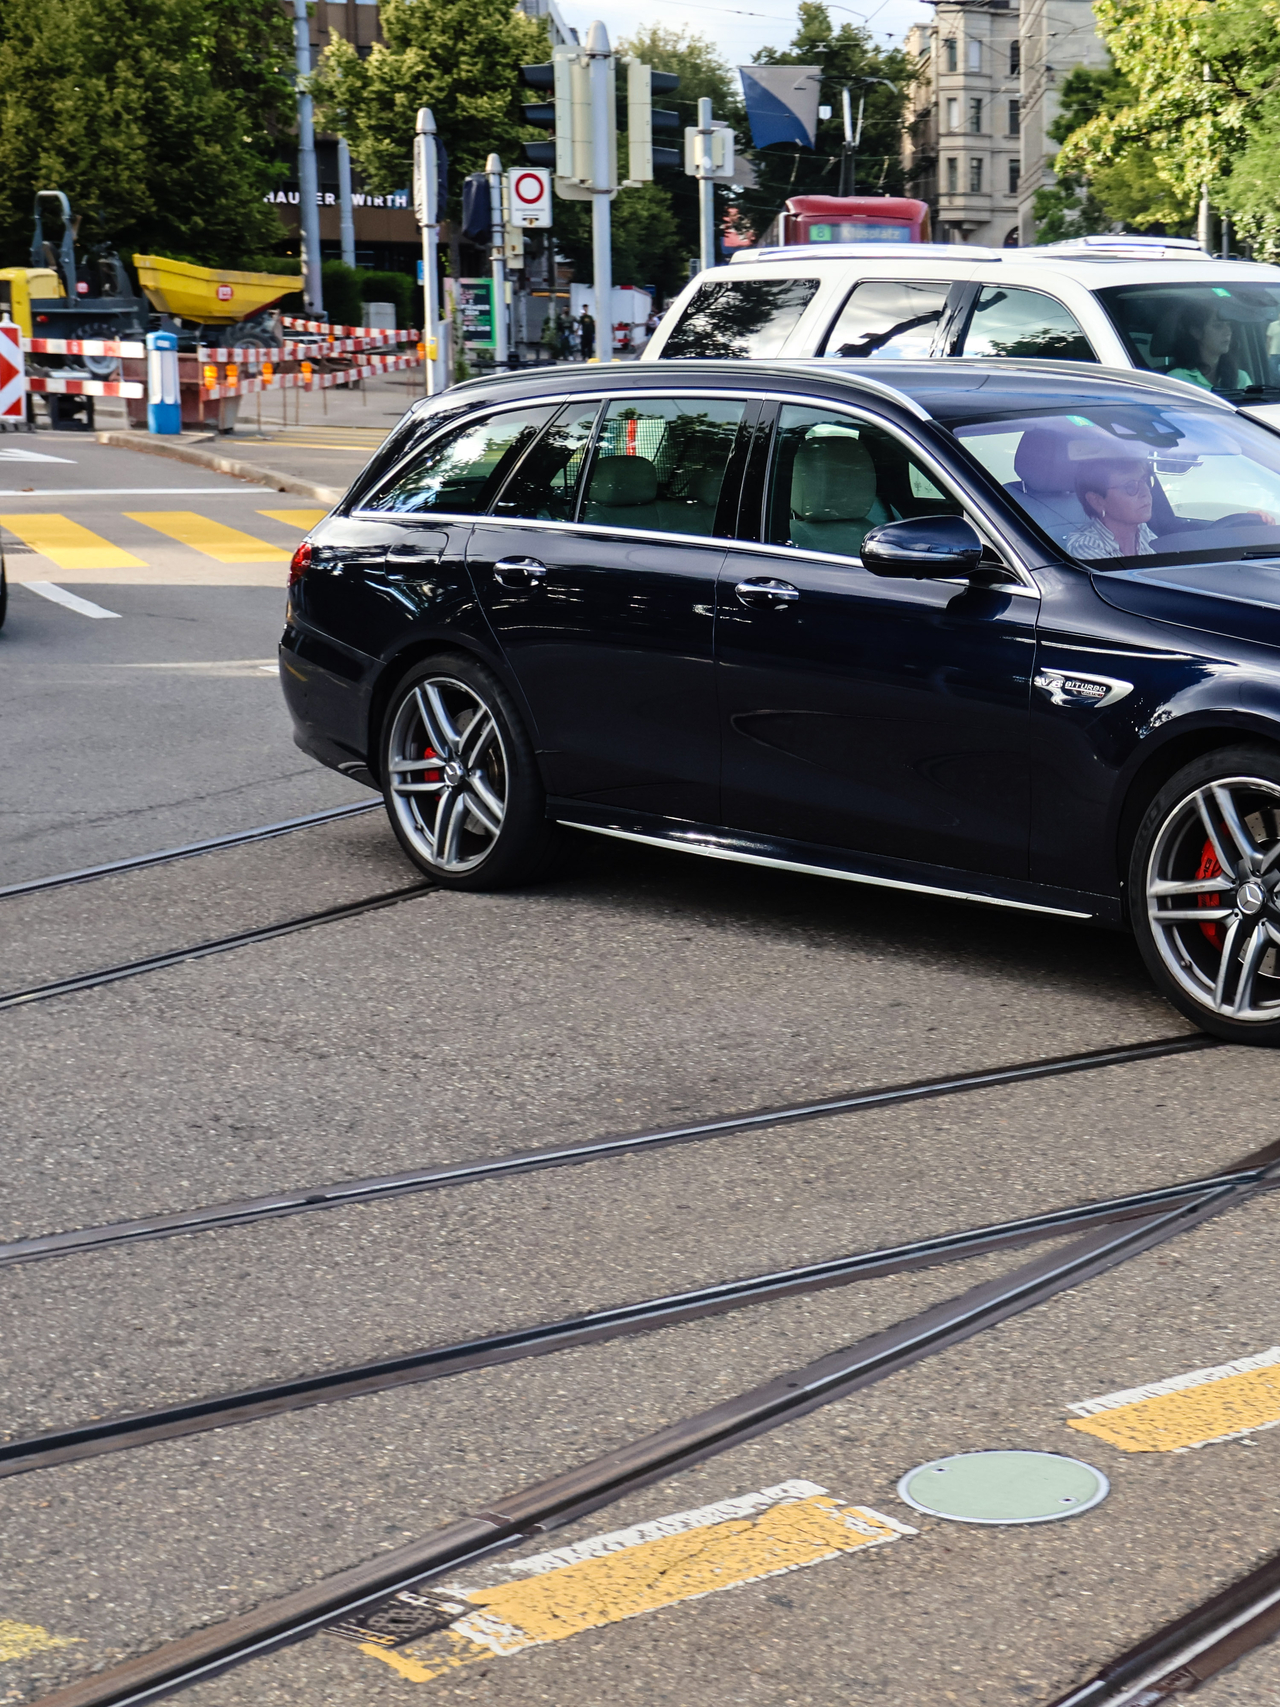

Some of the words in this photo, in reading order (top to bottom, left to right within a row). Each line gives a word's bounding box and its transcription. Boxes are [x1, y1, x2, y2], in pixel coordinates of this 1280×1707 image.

[263, 191, 336, 205] HAUER
[351, 193, 407, 207] WIRTH
[817, 226, 826, 238] 8
[1065, 680, 1106, 692] BITURBO
